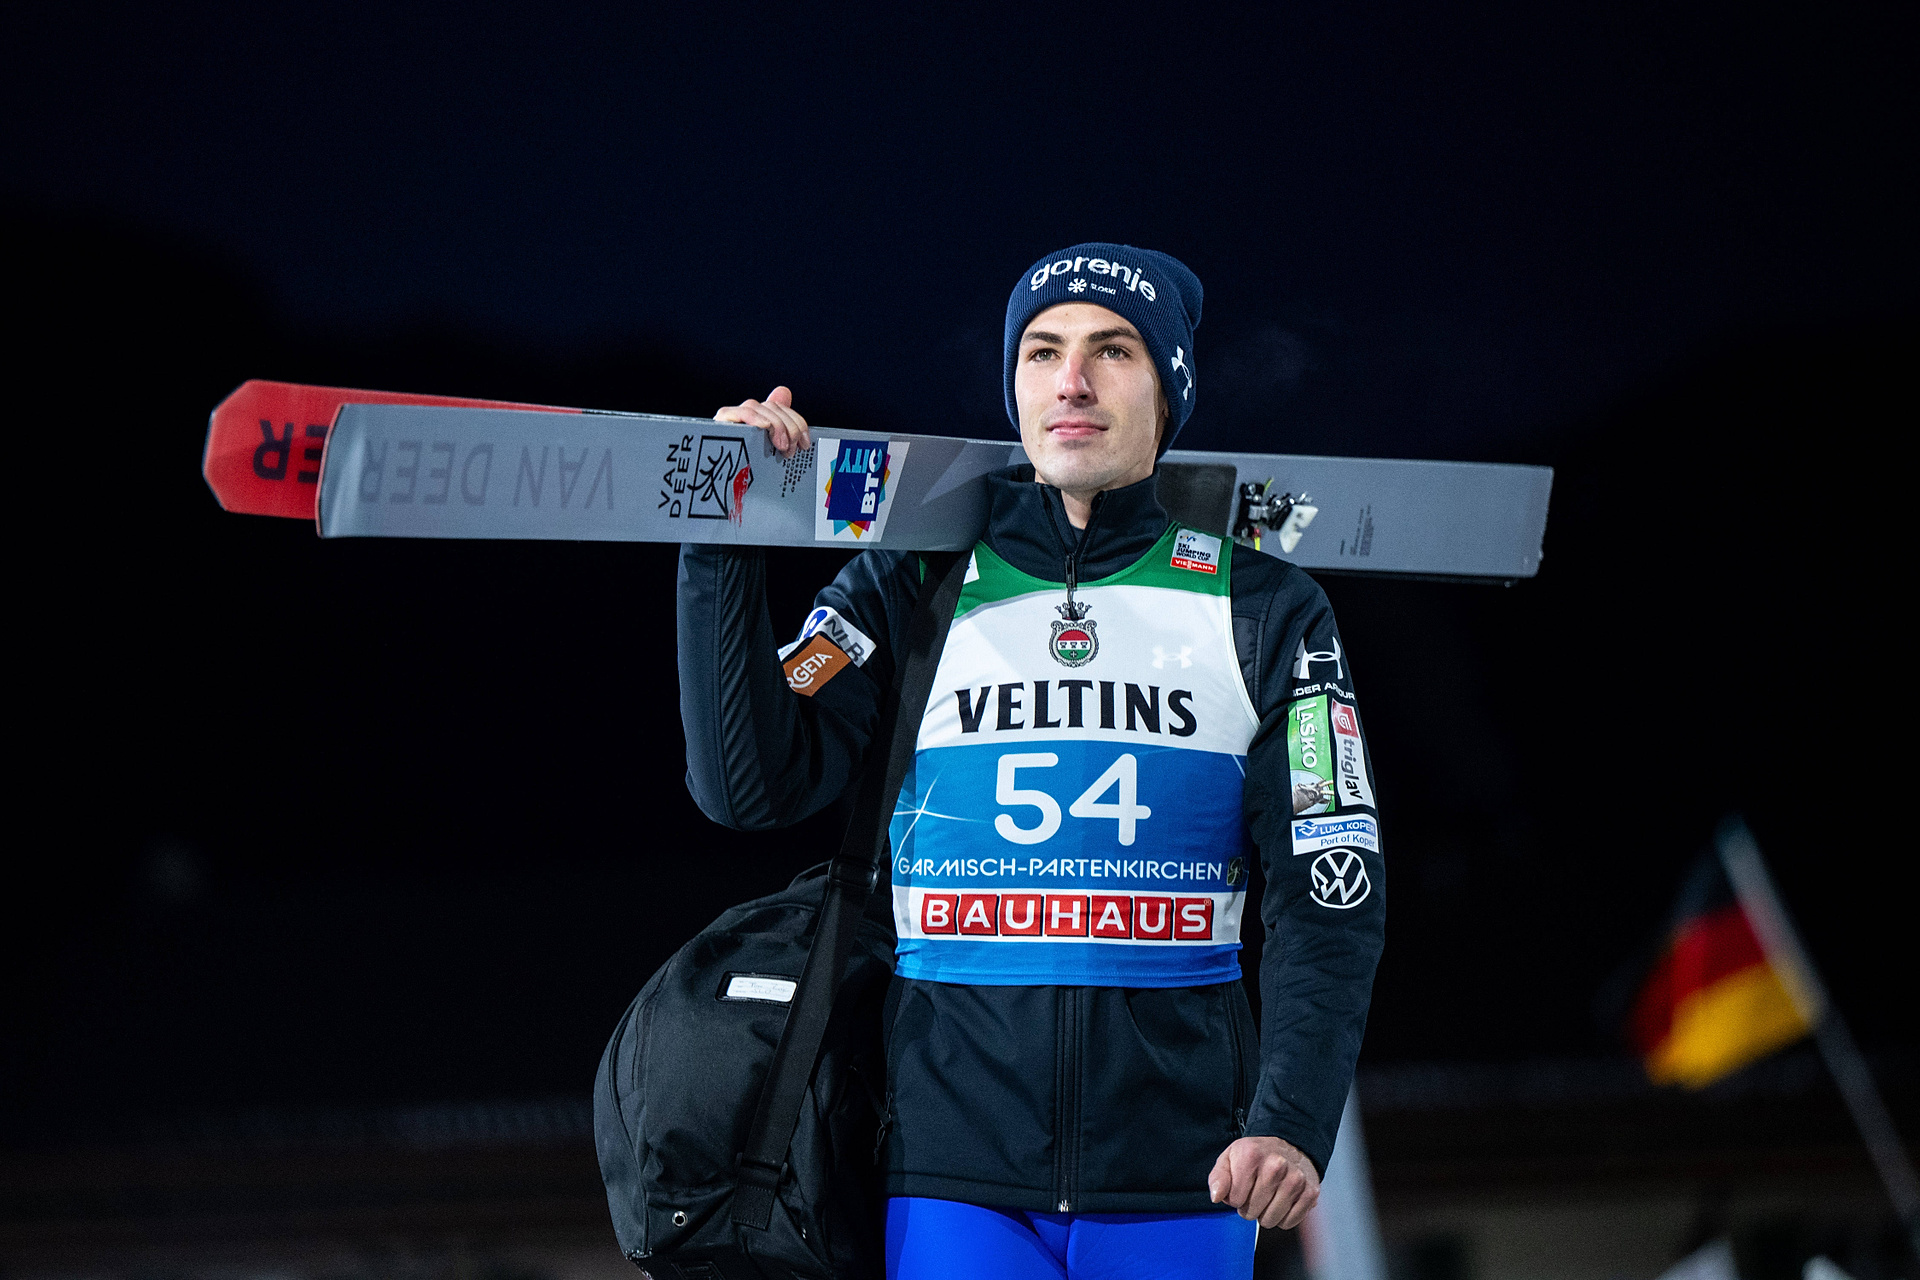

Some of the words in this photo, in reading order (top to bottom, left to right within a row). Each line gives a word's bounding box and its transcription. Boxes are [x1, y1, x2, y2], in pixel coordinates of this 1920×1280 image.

[1031, 256, 1156, 302] gorenje
[358, 440, 495, 507] DEER
[512, 444, 615, 510] VAN
[658, 444, 680, 509] VAN
[669, 434, 694, 518] DEER
[861, 448, 883, 514] BTC
[1176, 552, 1197, 560] WORLD
[1177, 547, 1211, 559] JUMPING
[1178, 542, 1190, 550] SKI
[954, 679, 1198, 738] VELTINS
[1293, 683, 1322, 697] DER
[1340, 738, 1364, 800] triglav
[994, 752, 1152, 846] 54
[1320, 824, 1344, 835] LUKA
[1320, 837, 1338, 847] Port
[1341, 834, 1350, 843] of
[1352, 833, 1375, 847] Koper
[898, 857, 1222, 881] GARMISCH-PARTENKIRCHEN
[925, 897, 1209, 934] BAUHAUS
